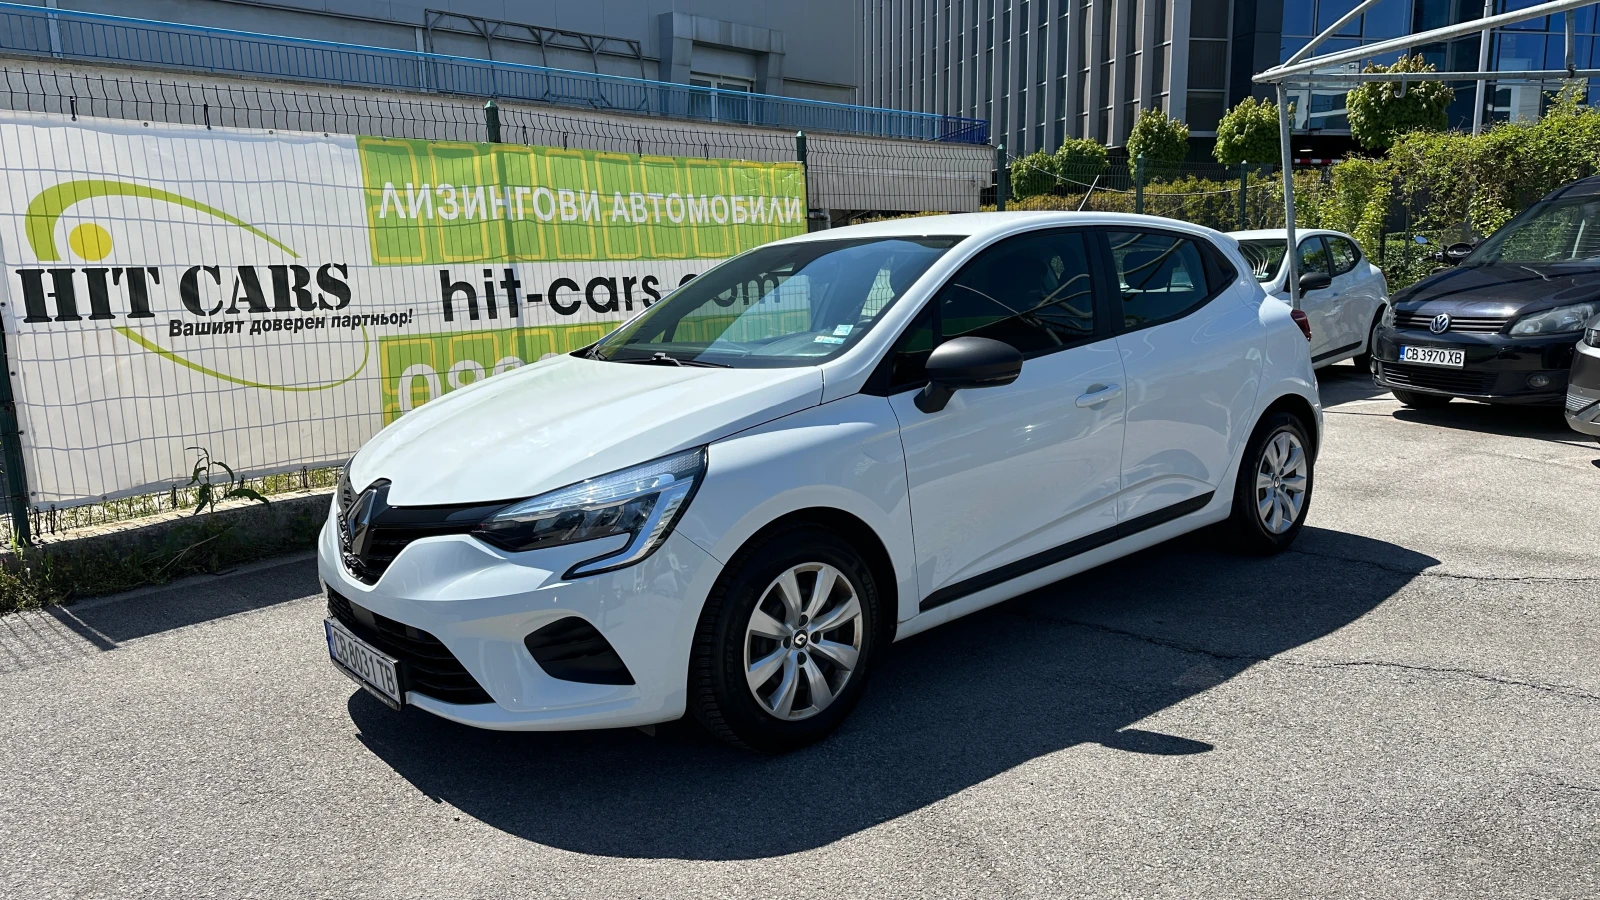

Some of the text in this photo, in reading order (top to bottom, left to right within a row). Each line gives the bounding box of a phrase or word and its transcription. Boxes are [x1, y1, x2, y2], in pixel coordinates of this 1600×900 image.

[379, 182, 802, 225] ЛИЗИНГОВИ АВТОМОБИЛИ
[15, 263, 352, 323] HIT CARS
[169, 308, 413, 337] Вашият доверен партньор!
[1405, 347, 1462, 364] CB 3970 XB
[333, 630, 349, 663] CB
[348, 641, 377, 683] 8031
[376, 659, 396, 695] TB
